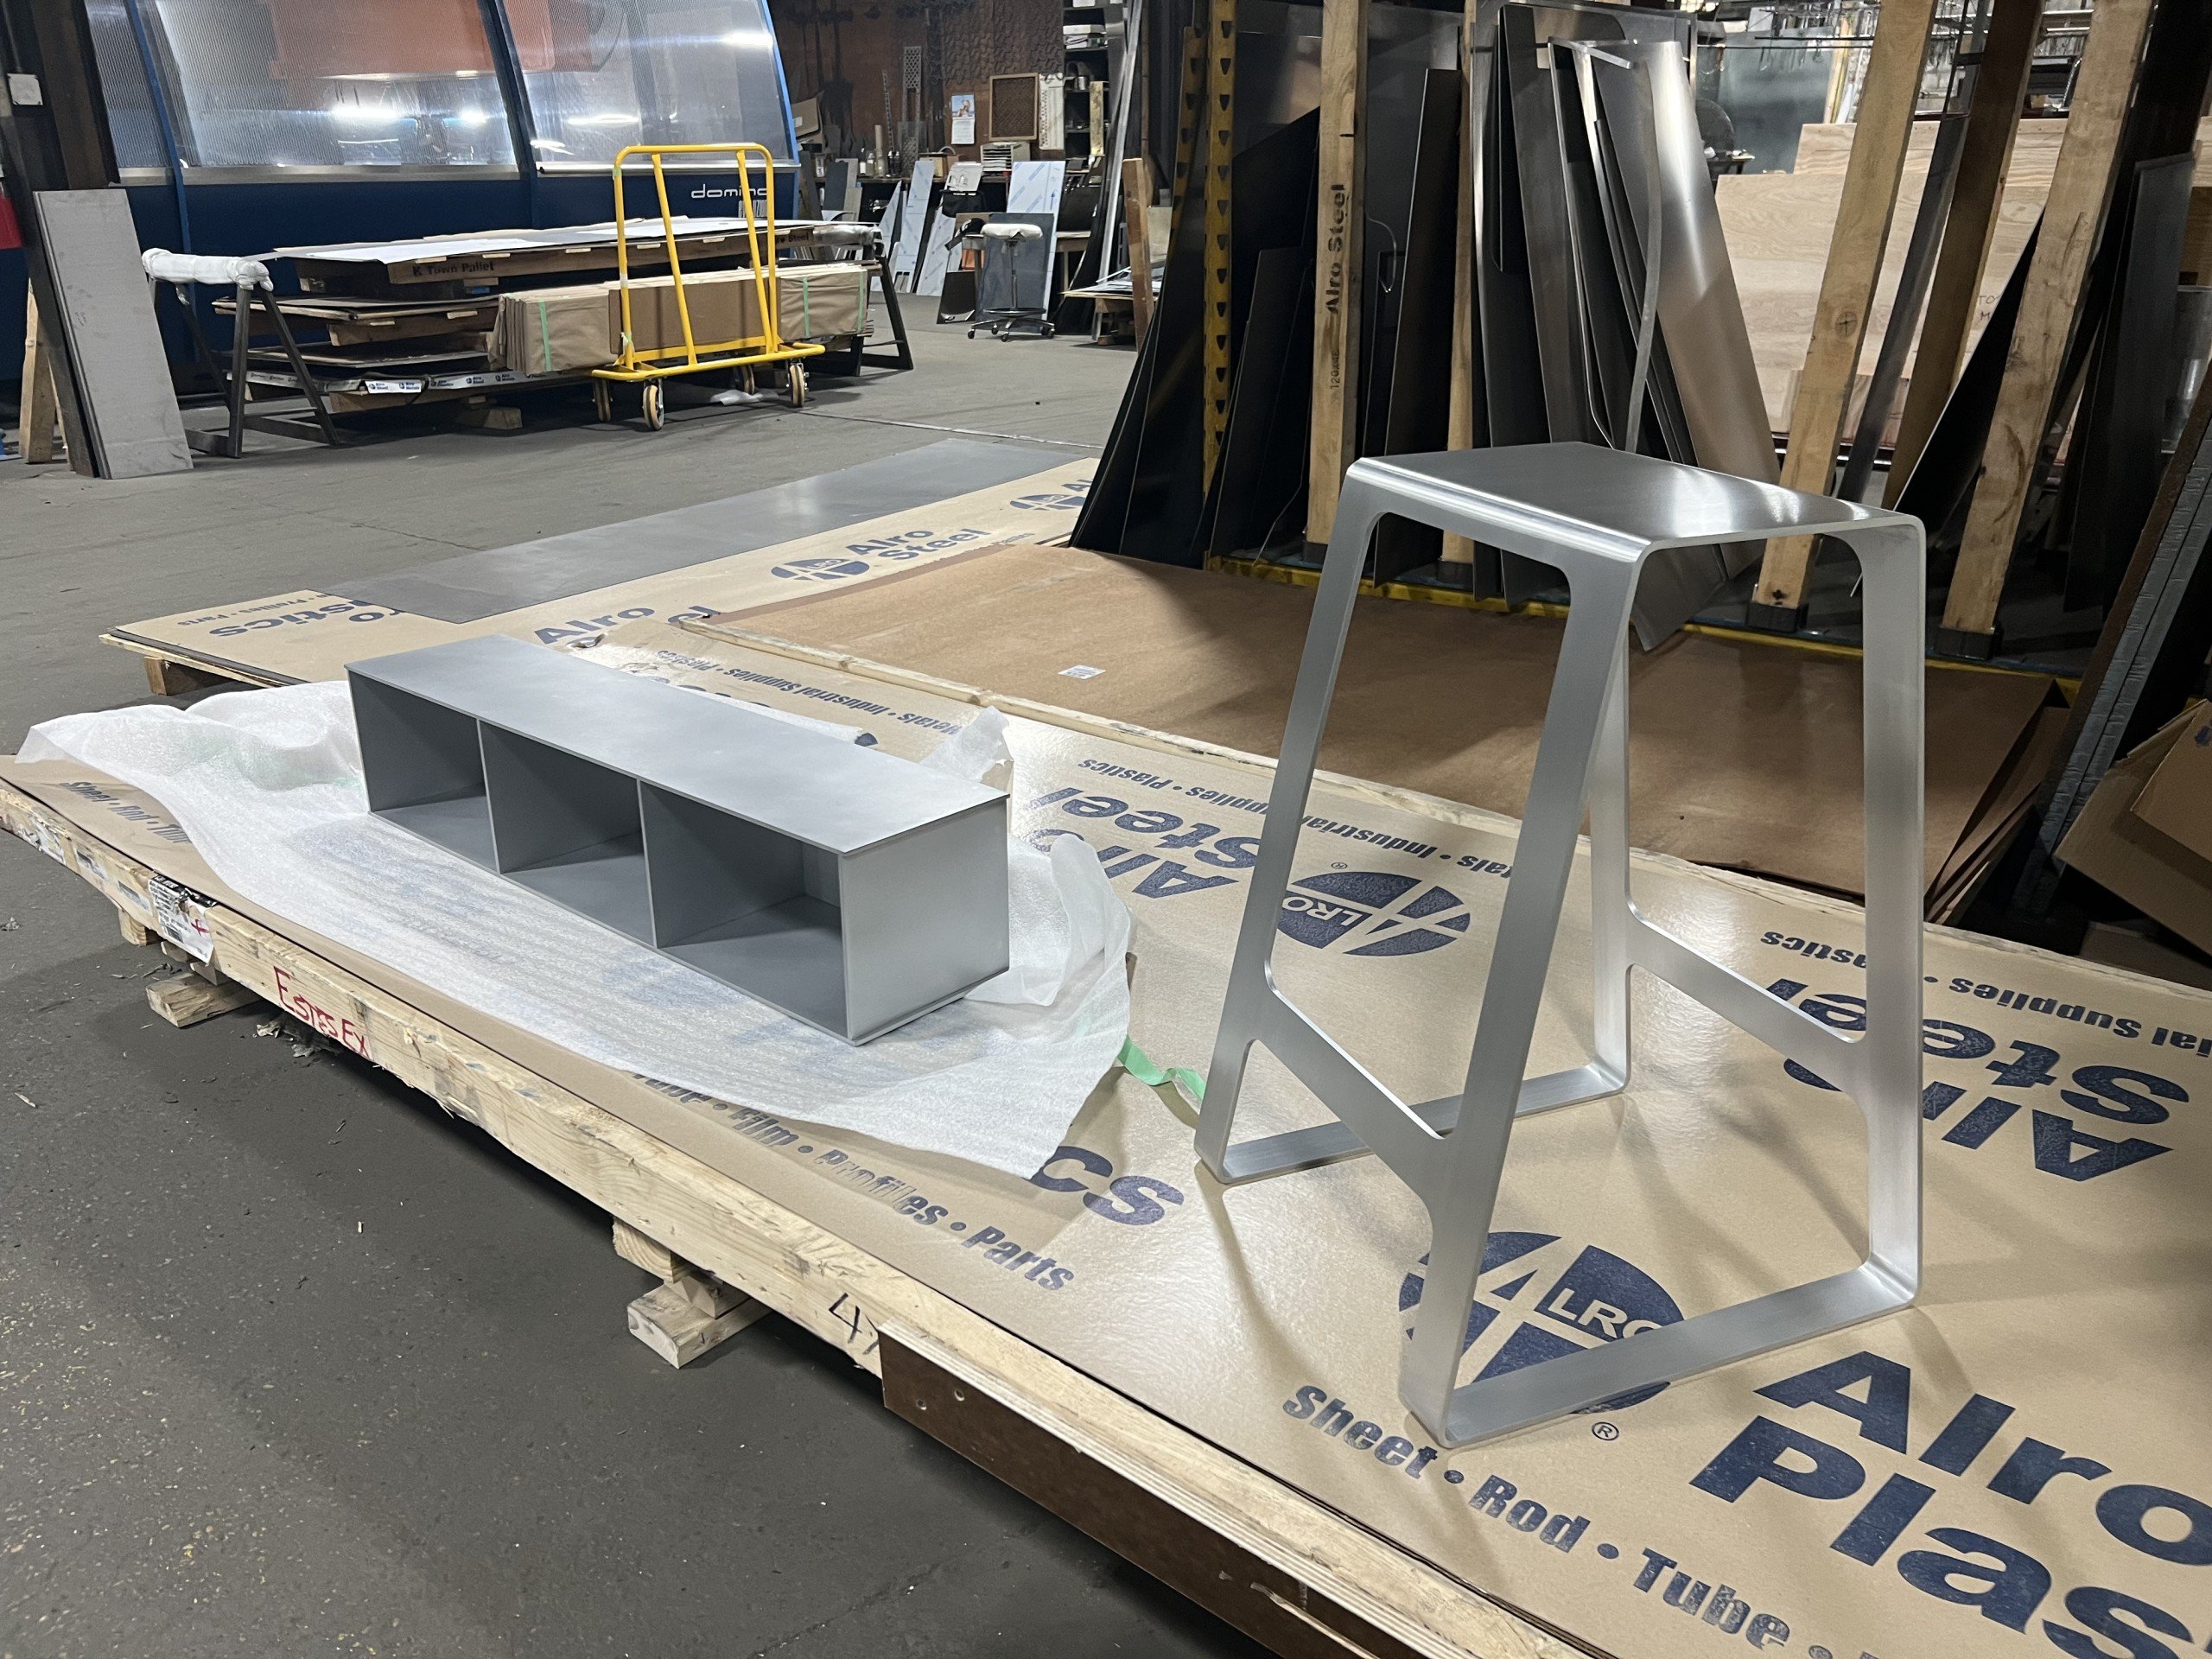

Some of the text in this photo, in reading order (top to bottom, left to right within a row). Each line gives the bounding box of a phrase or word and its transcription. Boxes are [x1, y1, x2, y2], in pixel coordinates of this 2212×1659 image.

[461, 261, 495, 272] Pallet
[1325, 183, 1345, 315] Alro Steel
[845, 531, 934, 556] Alro
[878, 528, 991, 561] Steel
[534, 607, 655, 645] Alro
[722, 668, 802, 691] Supplies
[792, 686, 892, 715] Industrial
[1077, 759, 1173, 791] Plastics
[1185, 786, 1269, 815] upplies
[1027, 787, 1261, 869] Steel
[1456, 855, 1513, 879] tals
[1760, 931, 1866, 969] astics
[1948, 977, 2142, 1039] Supplies
[728, 1107, 799, 1147] Film
[962, 1225, 1075, 1291] Parts
[1753, 1350, 2212, 1567] Alro
[1282, 1384, 1791, 1649] Sheet Rod Tube
